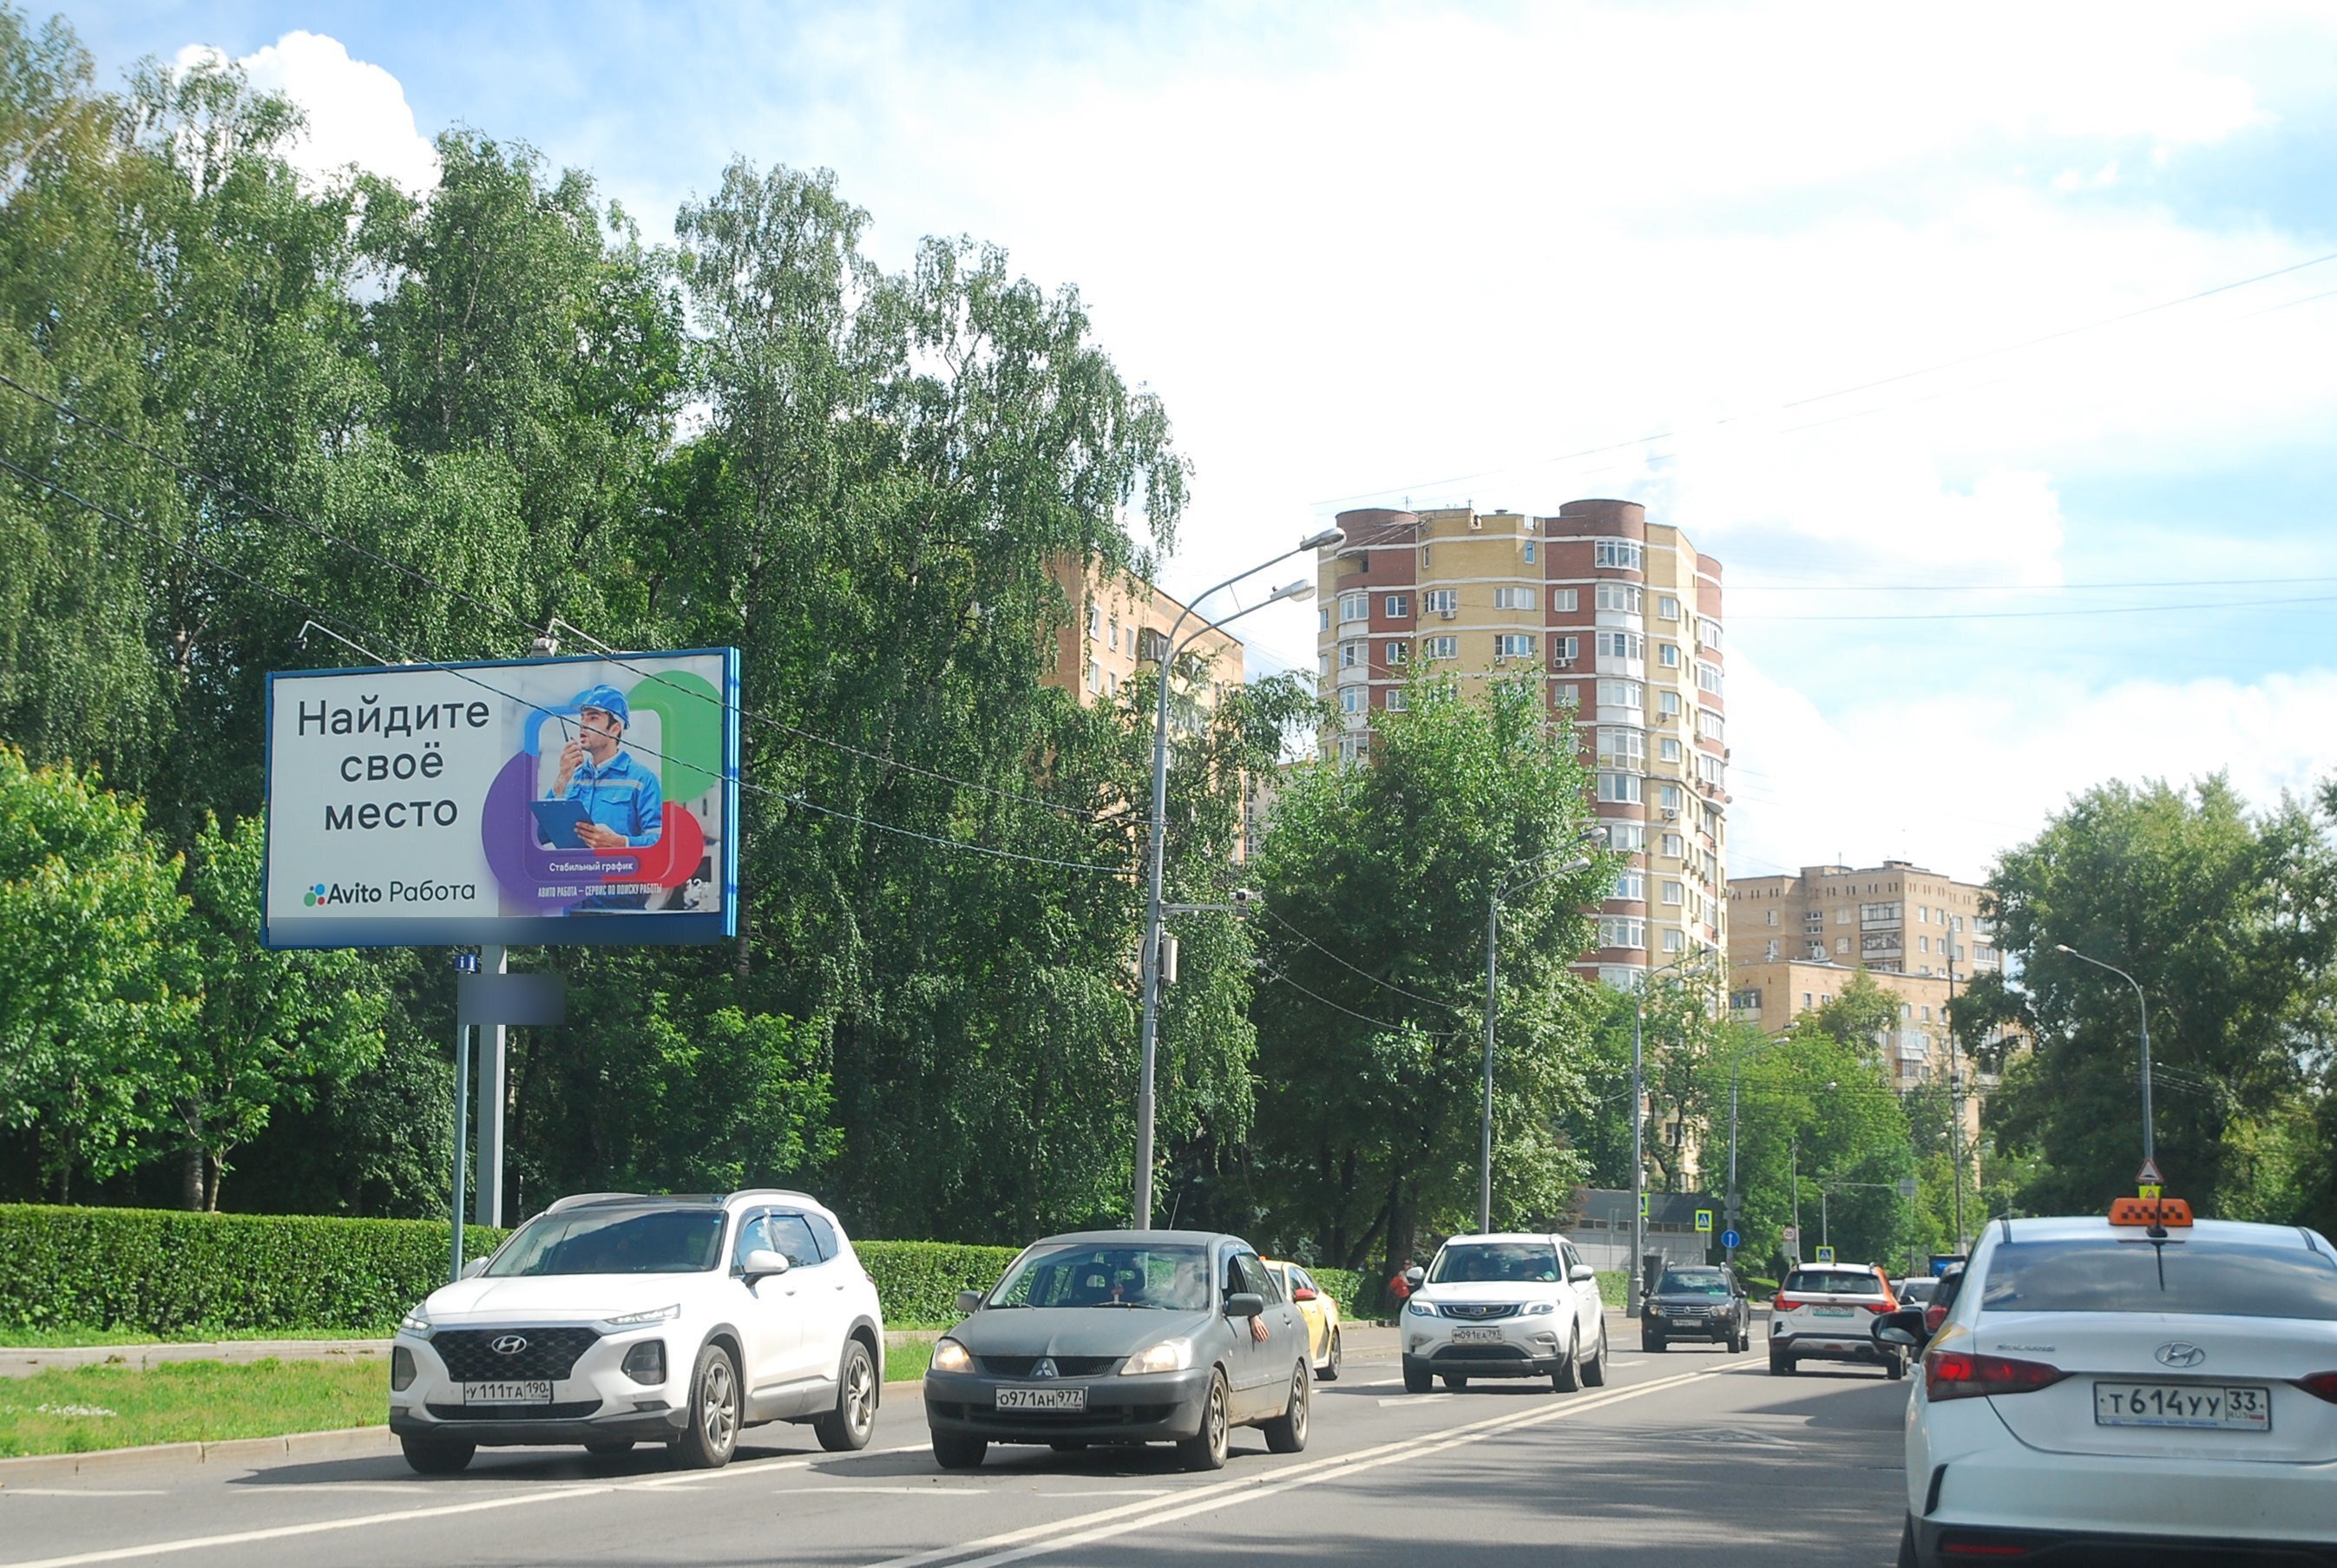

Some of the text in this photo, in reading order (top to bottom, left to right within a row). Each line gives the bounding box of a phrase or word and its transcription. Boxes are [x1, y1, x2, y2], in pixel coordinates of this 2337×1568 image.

[299, 694, 489, 738] Найдите
[340, 742, 443, 782] своё
[325, 799, 457, 830] место
[549, 860, 633, 872] Стабильный график
[326, 880, 476, 904] Avito Работа
[538, 887, 556, 898] АВИТО
[556, 886, 578, 898] РАБОТА
[585, 884, 607, 896] СЕРВИС
[640, 882, 662, 895] РАБОТЫ
[686, 878, 712, 892] 12+
[2229, 1390, 2256, 1412] 33
